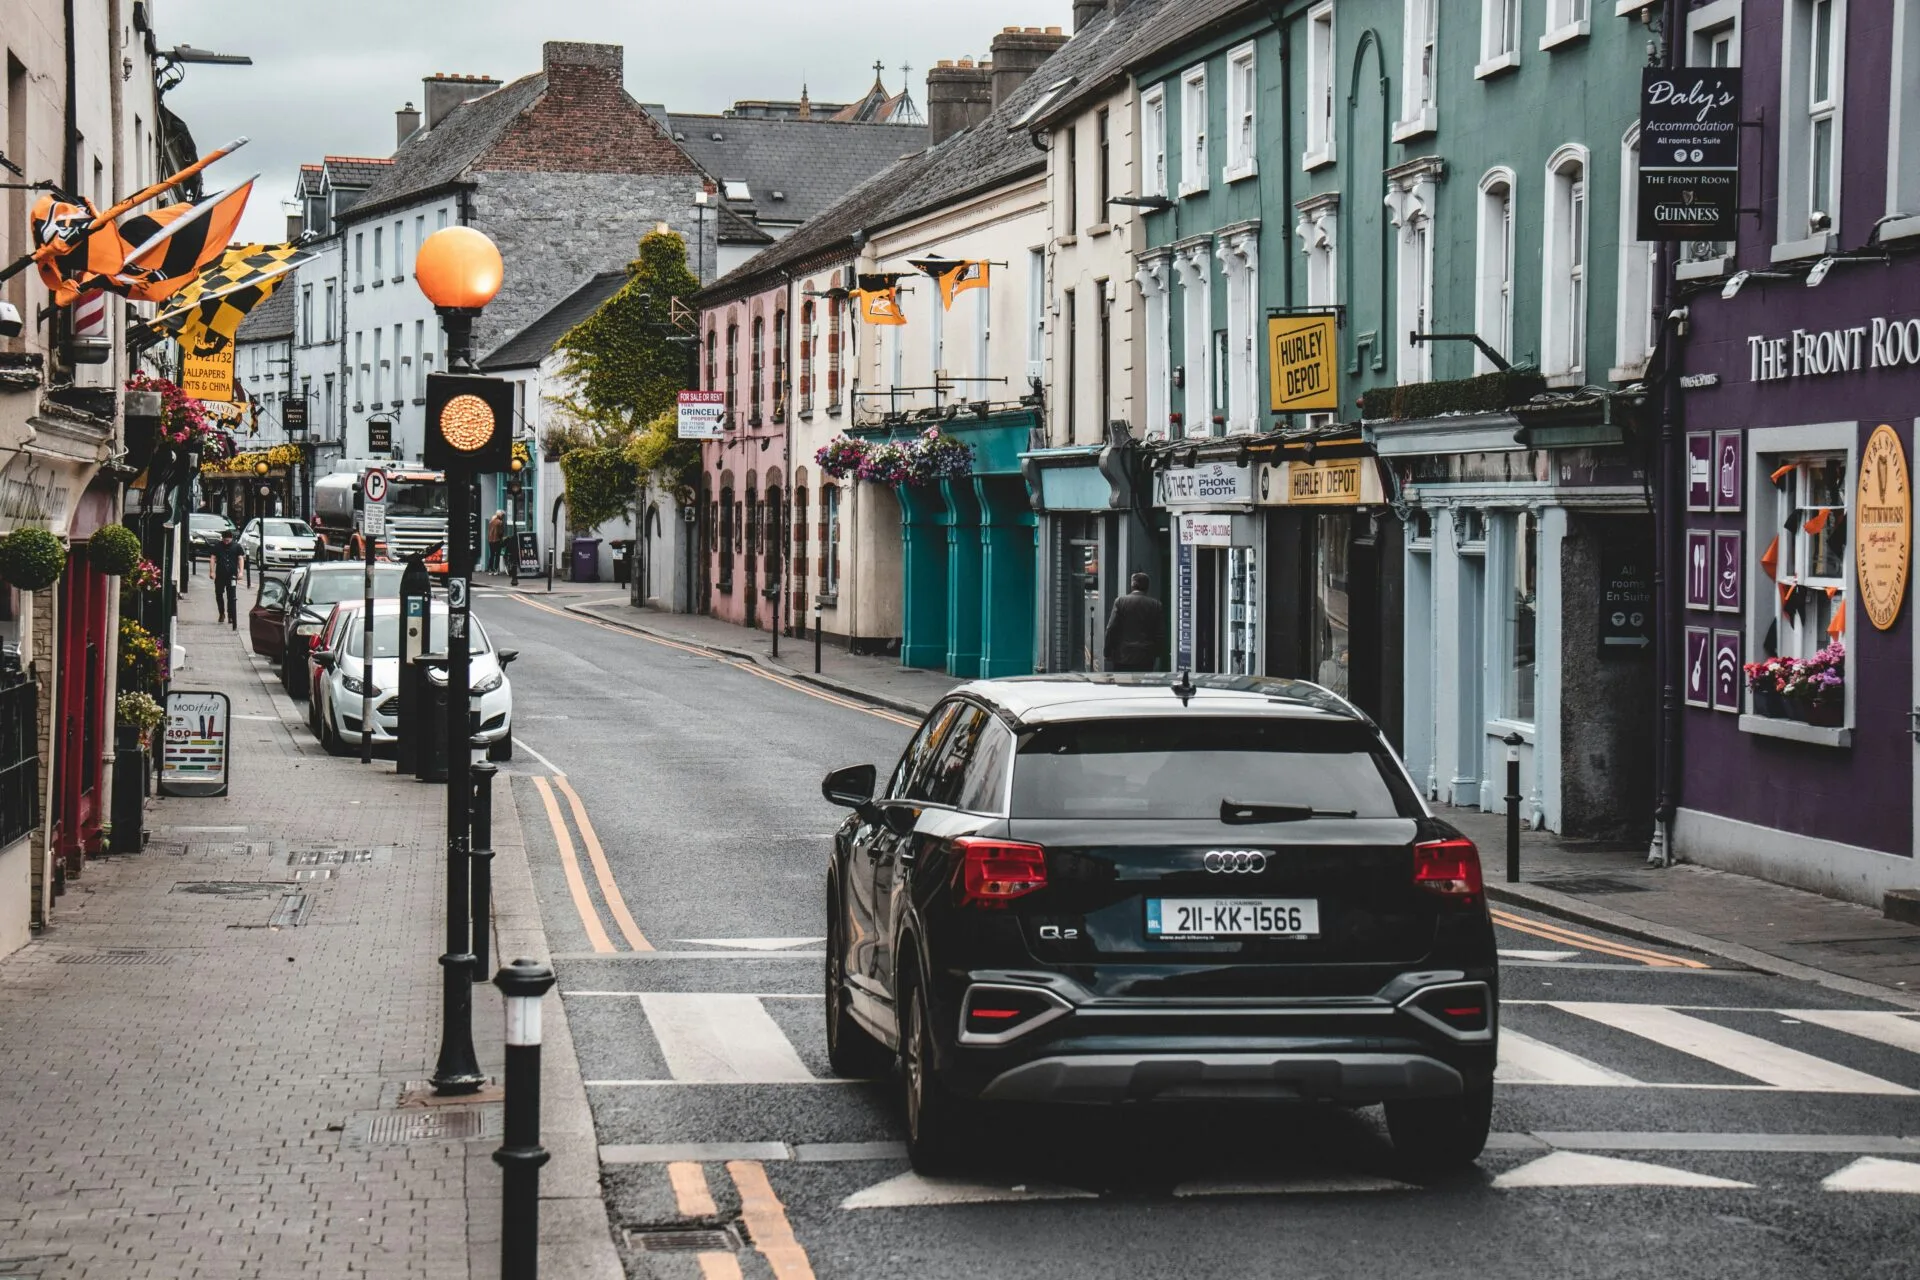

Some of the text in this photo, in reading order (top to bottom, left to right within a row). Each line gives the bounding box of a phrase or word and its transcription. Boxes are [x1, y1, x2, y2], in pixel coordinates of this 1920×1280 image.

[1648, 79, 1735, 122] Daly's
[1646, 120, 1734, 132] Accommodation
[1646, 175, 1730, 184] THE FRONT ROOM
[1654, 204, 1719, 221] GUINNESS
[1280, 330, 1322, 367] HURLEY
[1747, 316, 1920, 382] THE FRONT ROO
[1286, 362, 1321, 396] DEPOT
[209, 382, 231, 393] CHINA
[680, 393, 723, 401] FOR SALE OR RENT
[1198, 477, 1236, 487] PHONE
[1293, 468, 1356, 496] HURLEY DEPOT
[1199, 486, 1236, 496] BOOTH
[1861, 504, 1904, 523] GUINNESS
[1606, 591, 1650, 602] En Suite
[174, 701, 220, 714] MODified
[1148, 920, 1160, 928] IRL
[1177, 906, 1302, 932] 211-KK-1566
[1040, 925, 1078, 940] Q2
